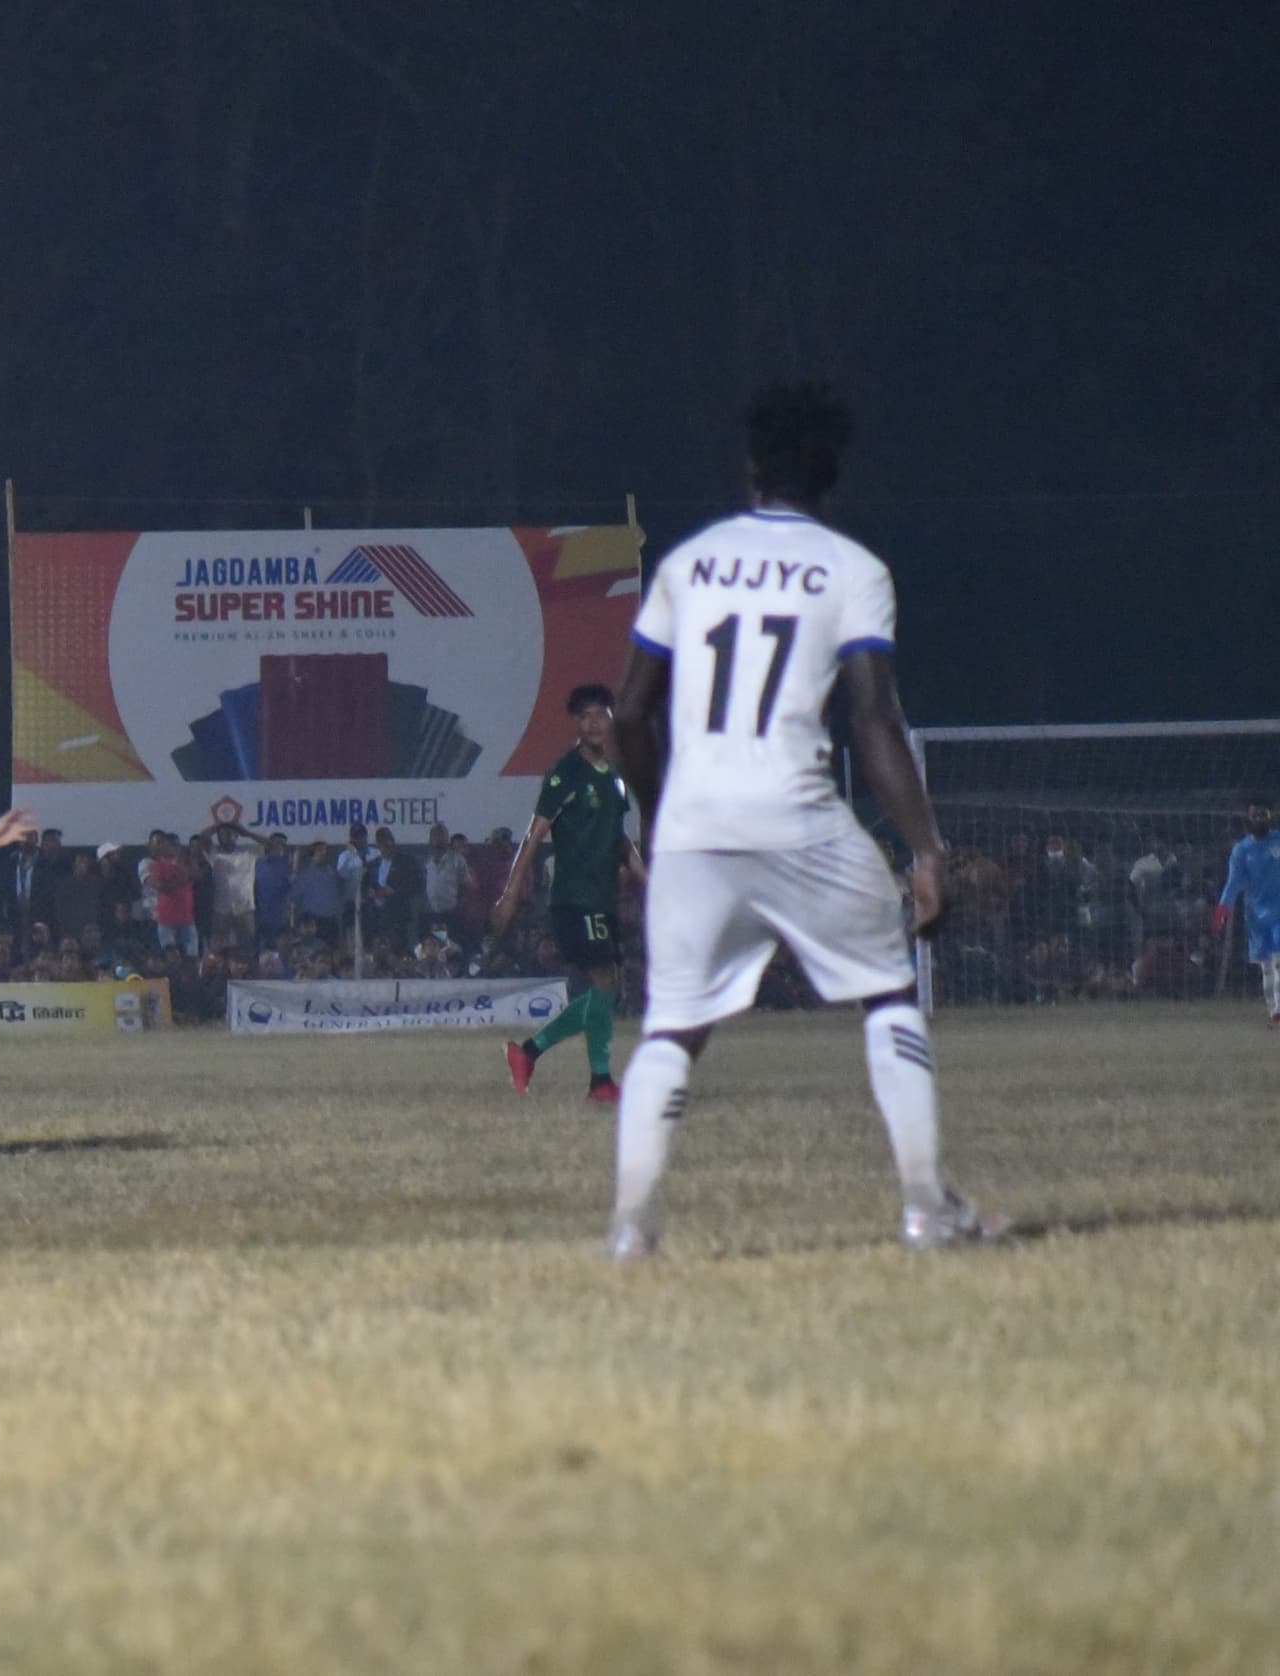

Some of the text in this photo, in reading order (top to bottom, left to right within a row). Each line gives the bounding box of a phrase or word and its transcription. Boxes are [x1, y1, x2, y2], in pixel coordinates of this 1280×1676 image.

[176, 557, 318, 587] JAGDAMBA
[690, 557, 828, 595] NJJYC
[175, 590, 395, 622] SUPER SHINE
[705, 613, 800, 738] 17
[249, 797, 444, 826] JAGDAMBA STEEL
[583, 913, 609, 941] 15
[474, 995, 495, 1011] &
